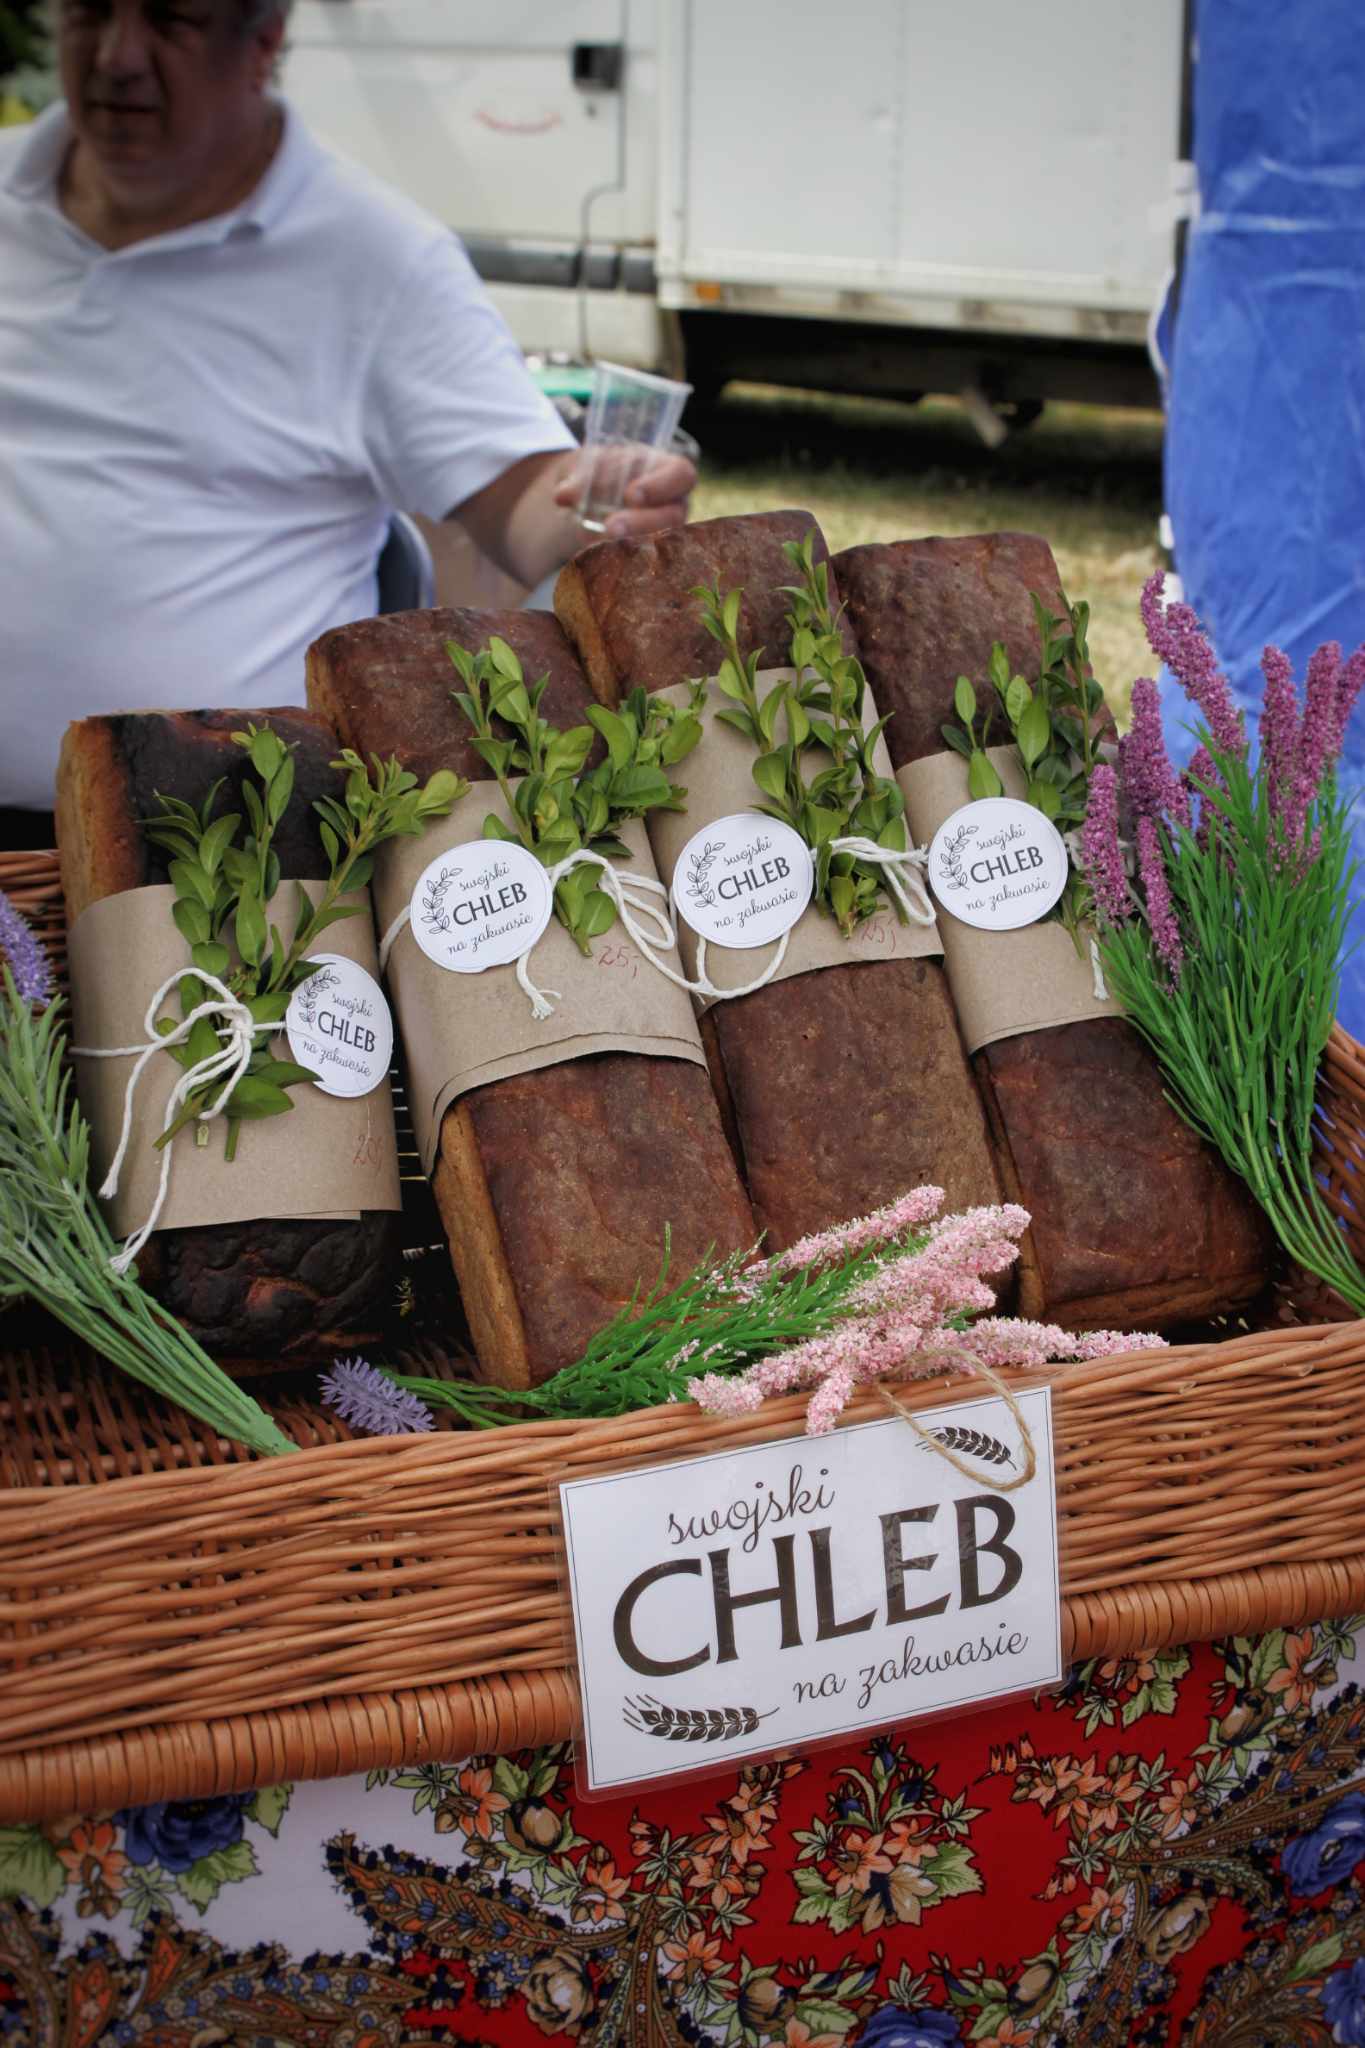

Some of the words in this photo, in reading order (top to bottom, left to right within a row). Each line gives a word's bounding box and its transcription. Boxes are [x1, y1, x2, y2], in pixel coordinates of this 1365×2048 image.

[723, 836, 773, 866] swojski
[976, 824, 1026, 850] swojski
[459, 861, 510, 891] swojski
[718, 857, 790, 900] CHLEB
[970, 846, 1044, 884] CHLEB
[452, 882, 527, 926] CHLEB
[714, 916, 734, 928] na
[737, 887, 798, 928] zakwasie
[966, 899, 985, 911] na
[989, 877, 1051, 912] zakwasie
[447, 940, 468, 954] na
[471, 912, 534, 952] zakwasie
[332, 993, 373, 1018] swojski
[318, 1011, 375, 1053] CHLEB
[303, 1040, 317, 1055] na
[319, 1047, 372, 1078] zakwasie
[668, 1464, 836, 1553] swojski
[612, 1493, 1023, 1678] CHLEB
[792, 1678, 846, 1703] na
[857, 1622, 1030, 1710] zakwasie
